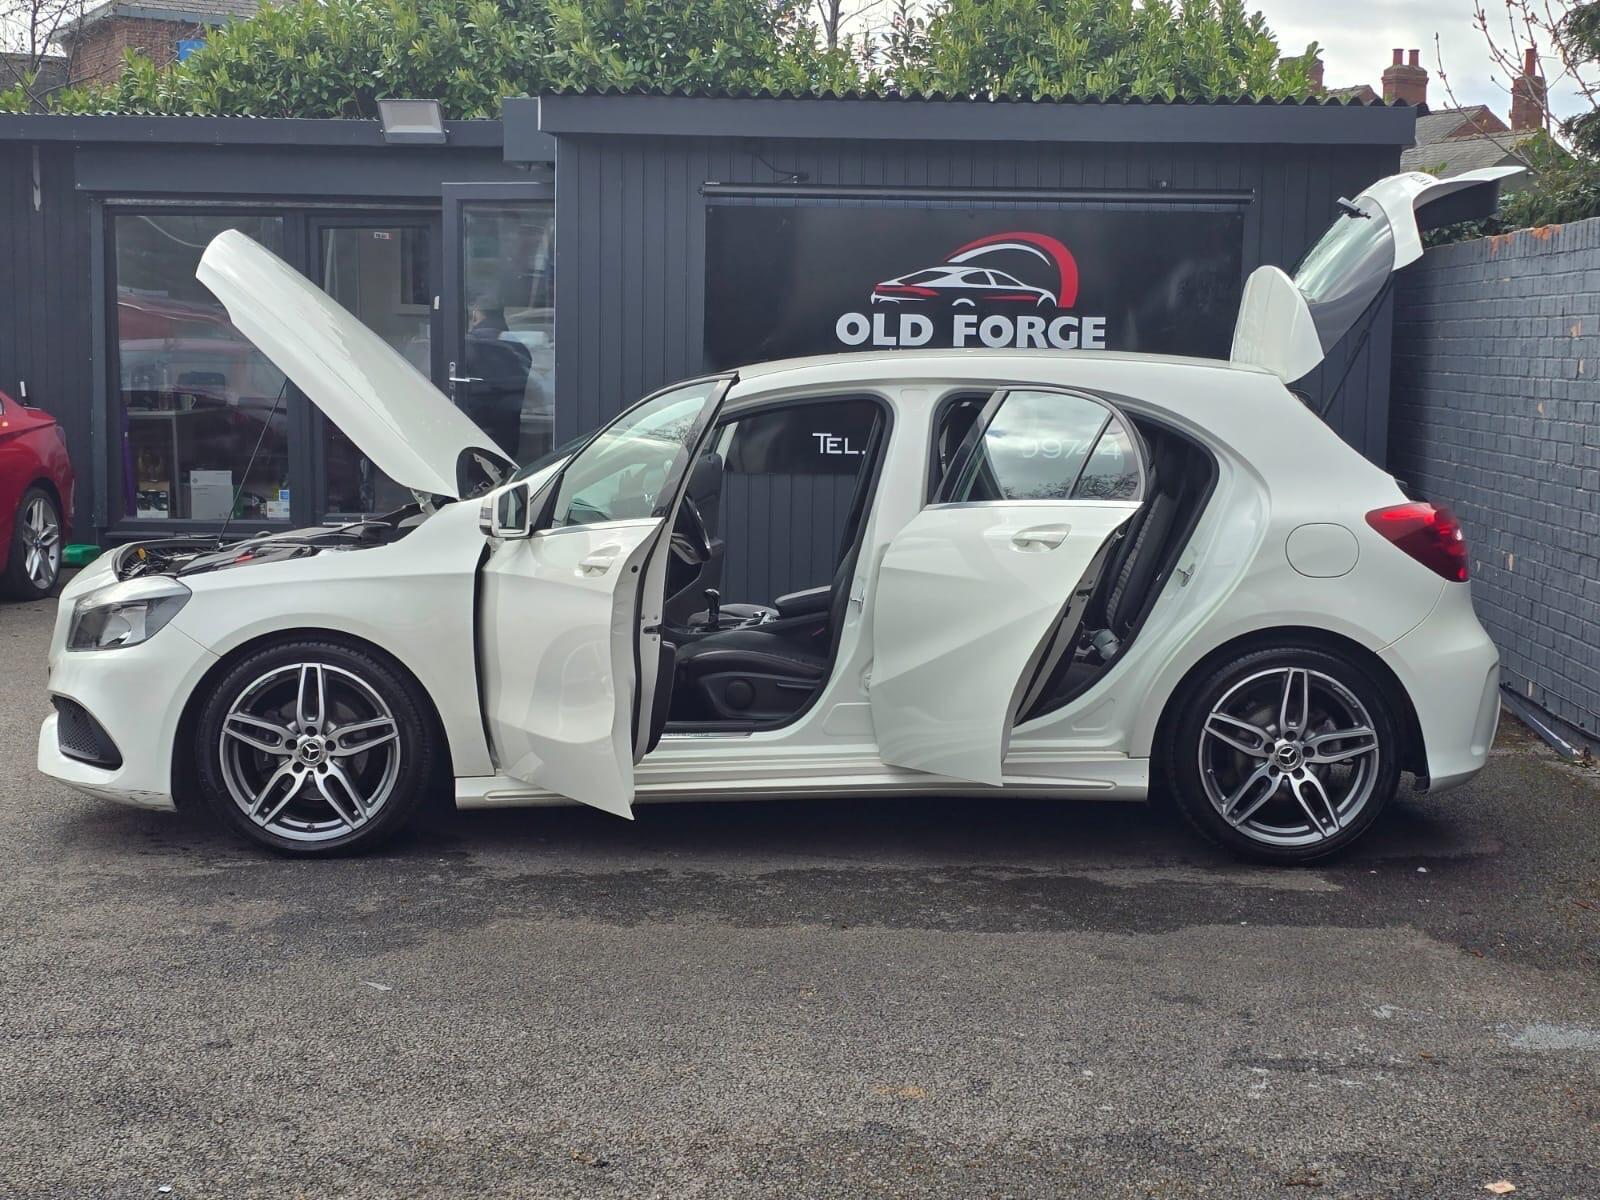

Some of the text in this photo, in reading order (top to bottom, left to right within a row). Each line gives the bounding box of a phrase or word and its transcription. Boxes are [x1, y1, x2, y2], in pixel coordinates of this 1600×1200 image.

[835, 312, 1107, 349] OLD FORGE
[812, 432, 866, 455] TEL.
